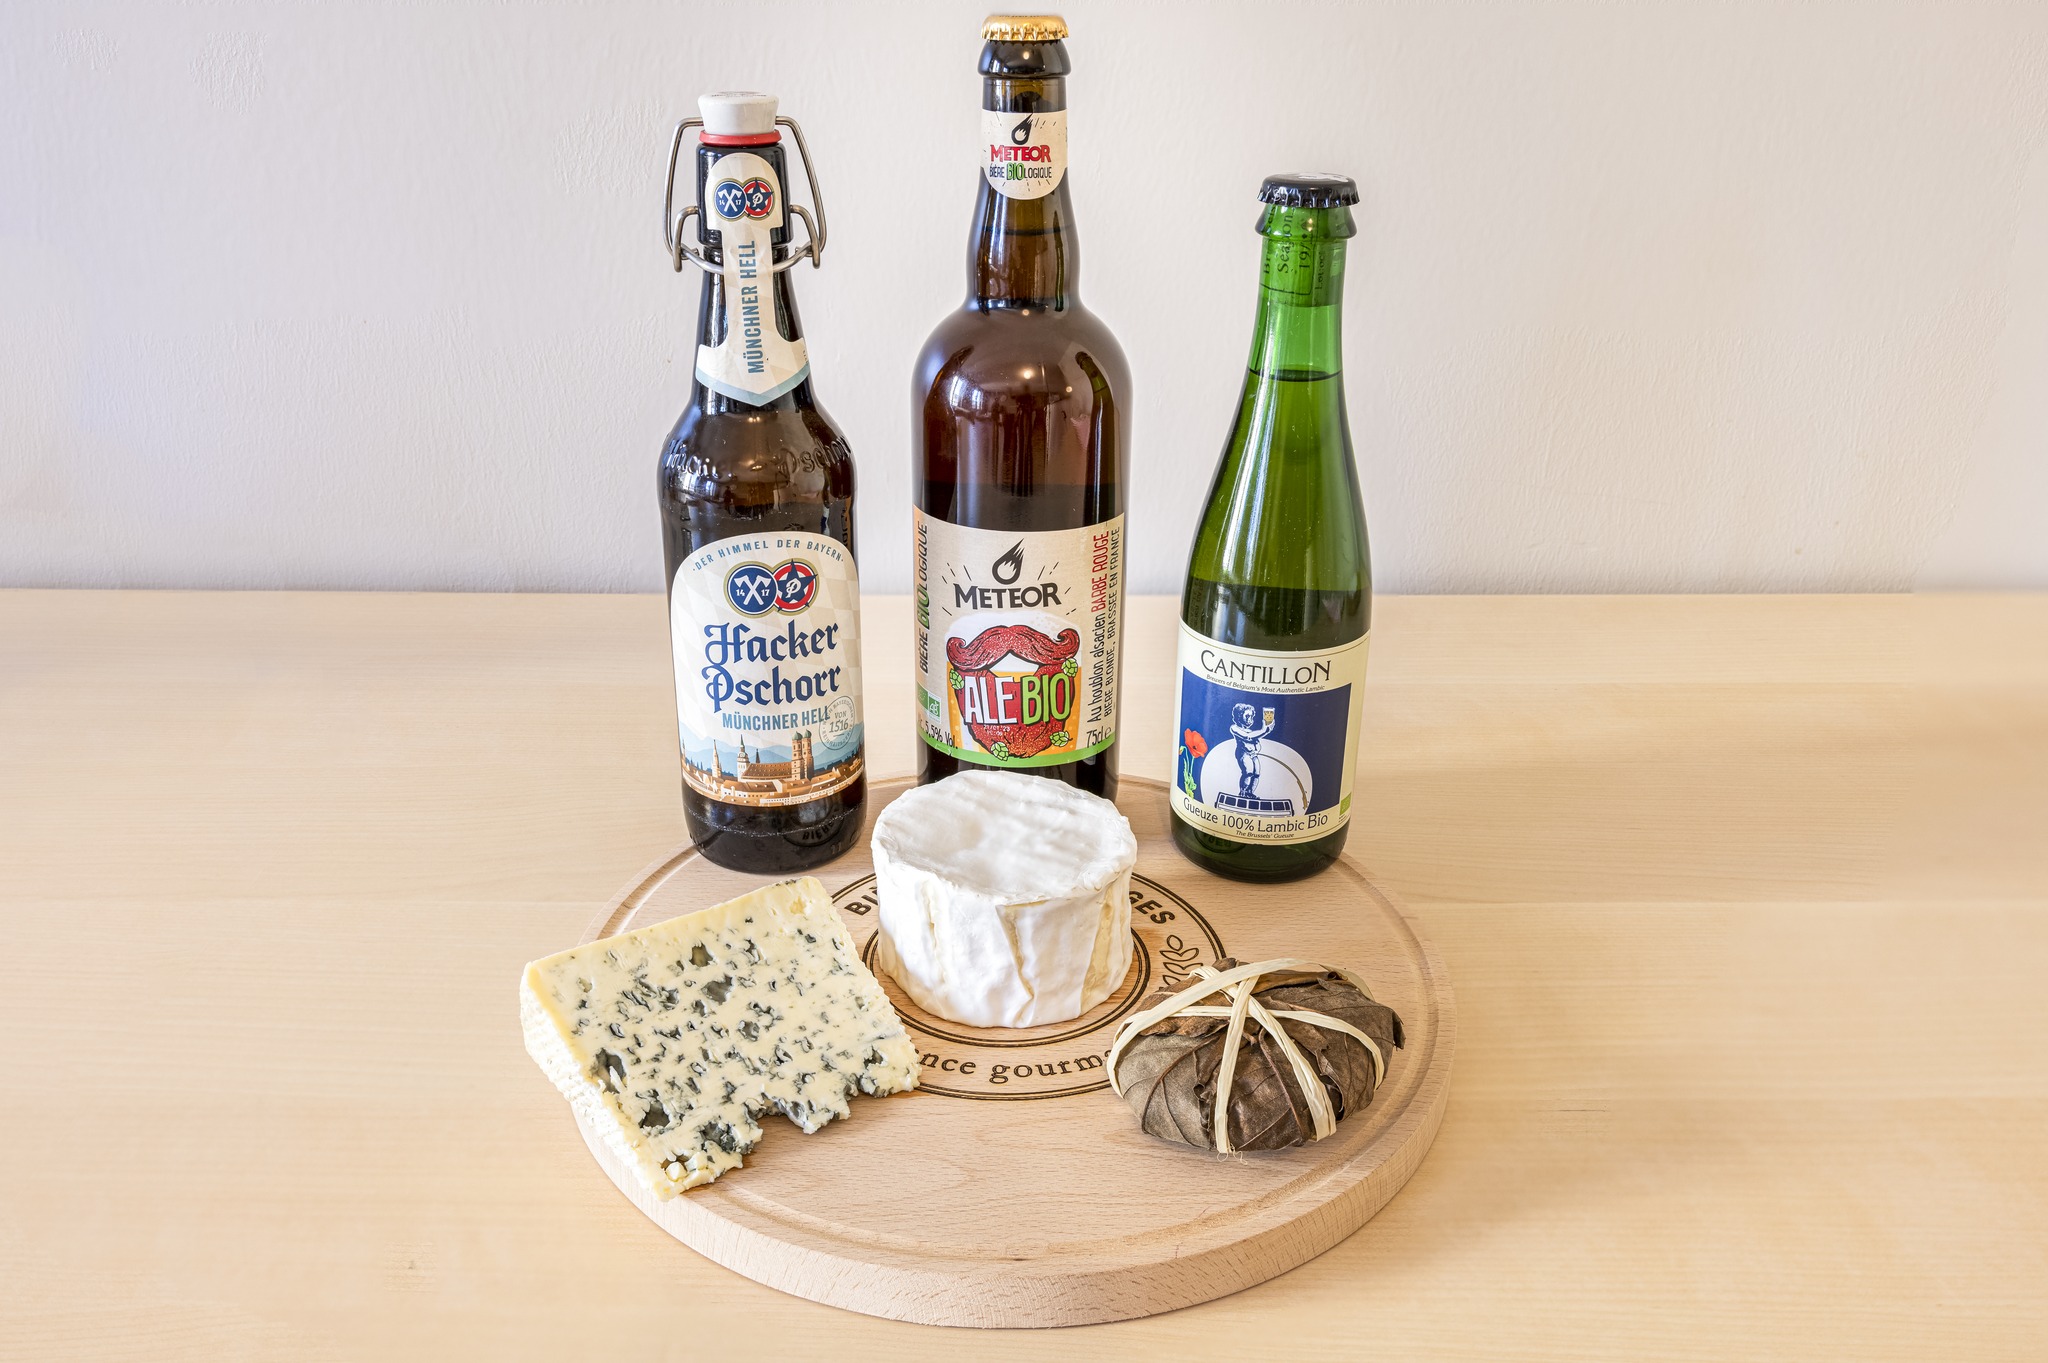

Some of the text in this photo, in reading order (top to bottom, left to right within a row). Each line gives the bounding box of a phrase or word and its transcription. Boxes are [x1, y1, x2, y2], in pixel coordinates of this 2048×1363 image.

[990, 145, 1051, 162] METEOR
[1006, 162, 1052, 180] BIOLOGIQUE
[738, 240, 765, 374] MÜNCHNER HELL
[695, 539, 842, 571] DER HIMMEL DER BAYERN
[1110, 526, 1120, 570] FRANCE
[916, 521, 930, 630] BIOLOGIQUE
[1109, 571, 1118, 587] EN
[761, 589, 770, 597] 17
[953, 582, 1062, 609] METEOR
[1087, 531, 1109, 723] Au houblon alsacien BARBE ROUGE
[703, 619, 839, 666] Hacker
[1200, 650, 1331, 684] CANTILLON
[701, 665, 841, 714] Pschorr
[1206, 674, 1226, 685] Brewers
[1232, 682, 1260, 692] Belgium's
[964, 672, 1071, 725] ALE BIO
[722, 711, 798, 731] MÜNCHNER
[802, 706, 830, 727] HELL
[828, 719, 849, 733] 1516
[834, 710, 847, 719] VON
[925, 720, 943, 742] 5,5%
[945, 731, 959, 750] Vol.
[1086, 726, 1105, 748] 75cl
[1183, 797, 1218, 824] Gueuze
[1222, 814, 1254, 832] 100%
[1257, 820, 1304, 833] Lambic
[1307, 814, 1328, 829] Bio
[844, 886, 878, 916] BI
[914, 1049, 977, 1075] nce
